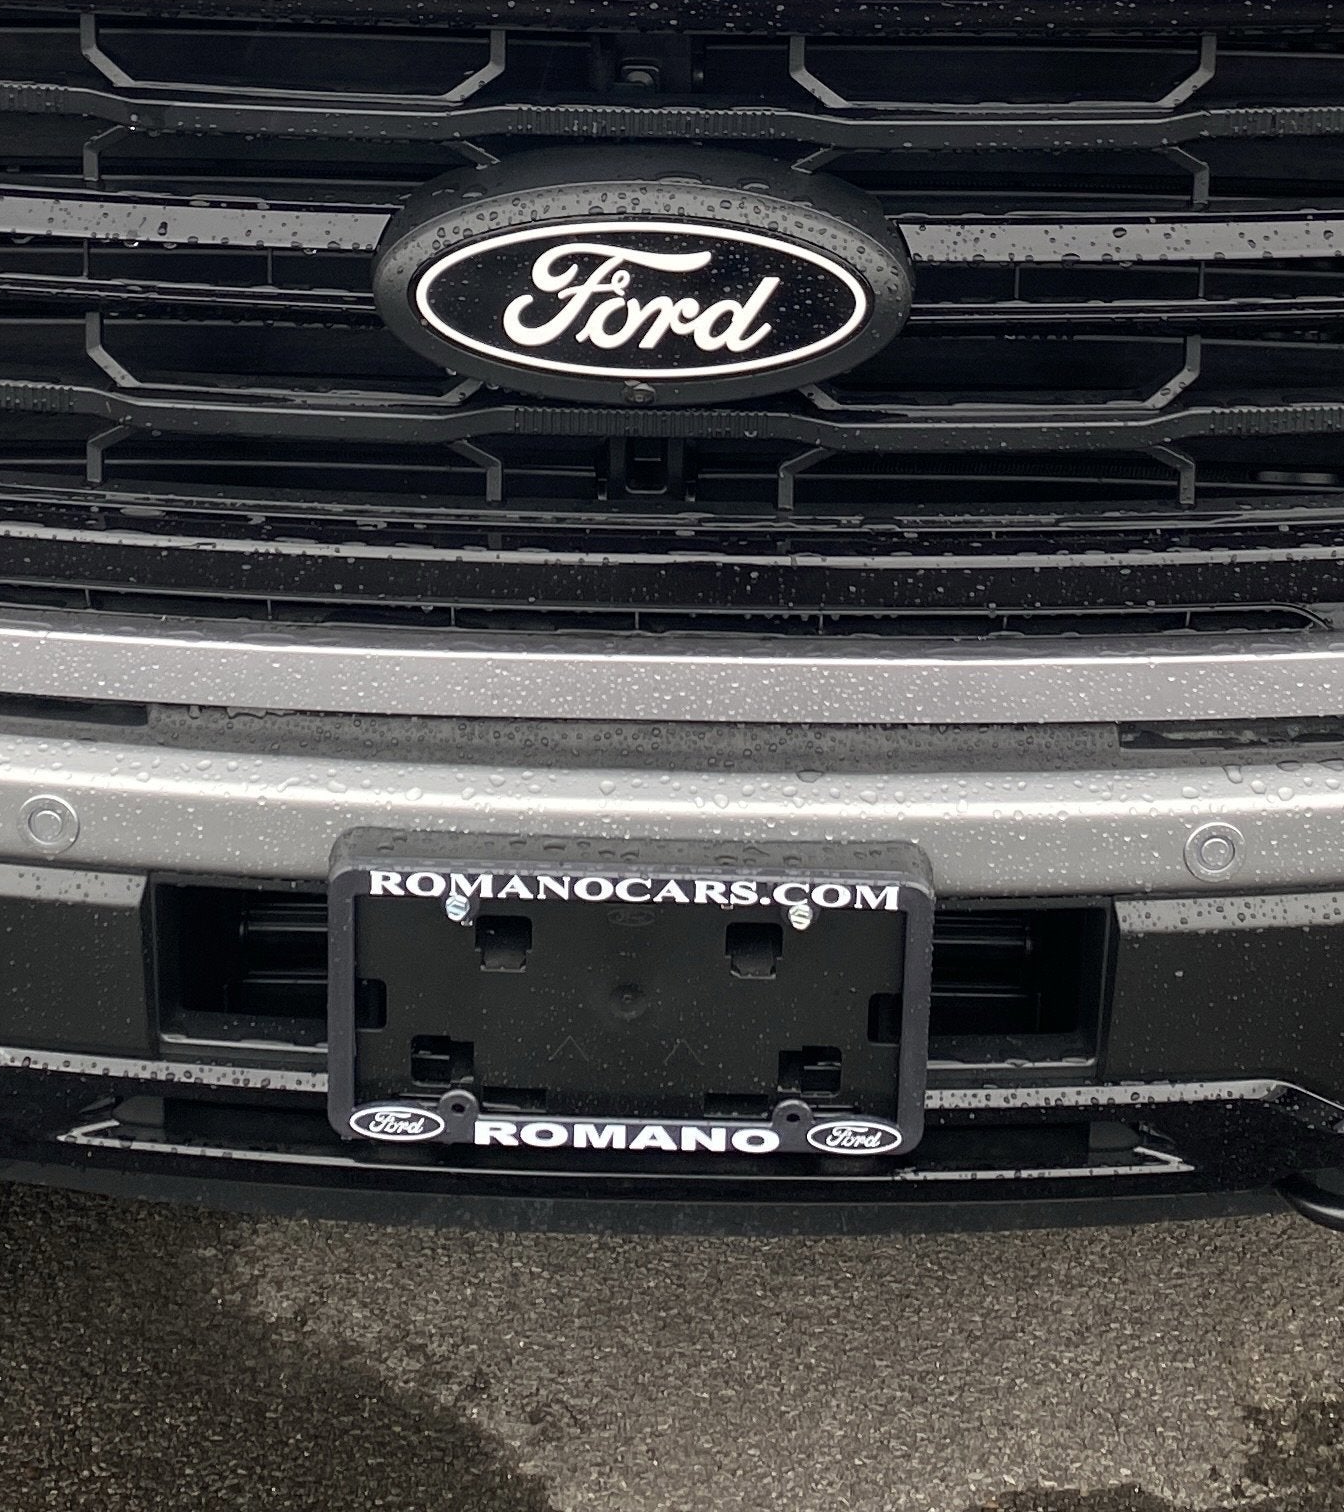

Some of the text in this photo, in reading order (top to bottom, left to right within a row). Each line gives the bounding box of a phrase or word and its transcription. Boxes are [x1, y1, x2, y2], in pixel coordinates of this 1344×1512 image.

[502, 242, 780, 352] Ford
[369, 870, 900, 911] ROMANOCARS.COM
[369, 1112, 425, 1134] Ford
[474, 1120, 780, 1153] ROMANO
[826, 1126, 882, 1148] Ford
